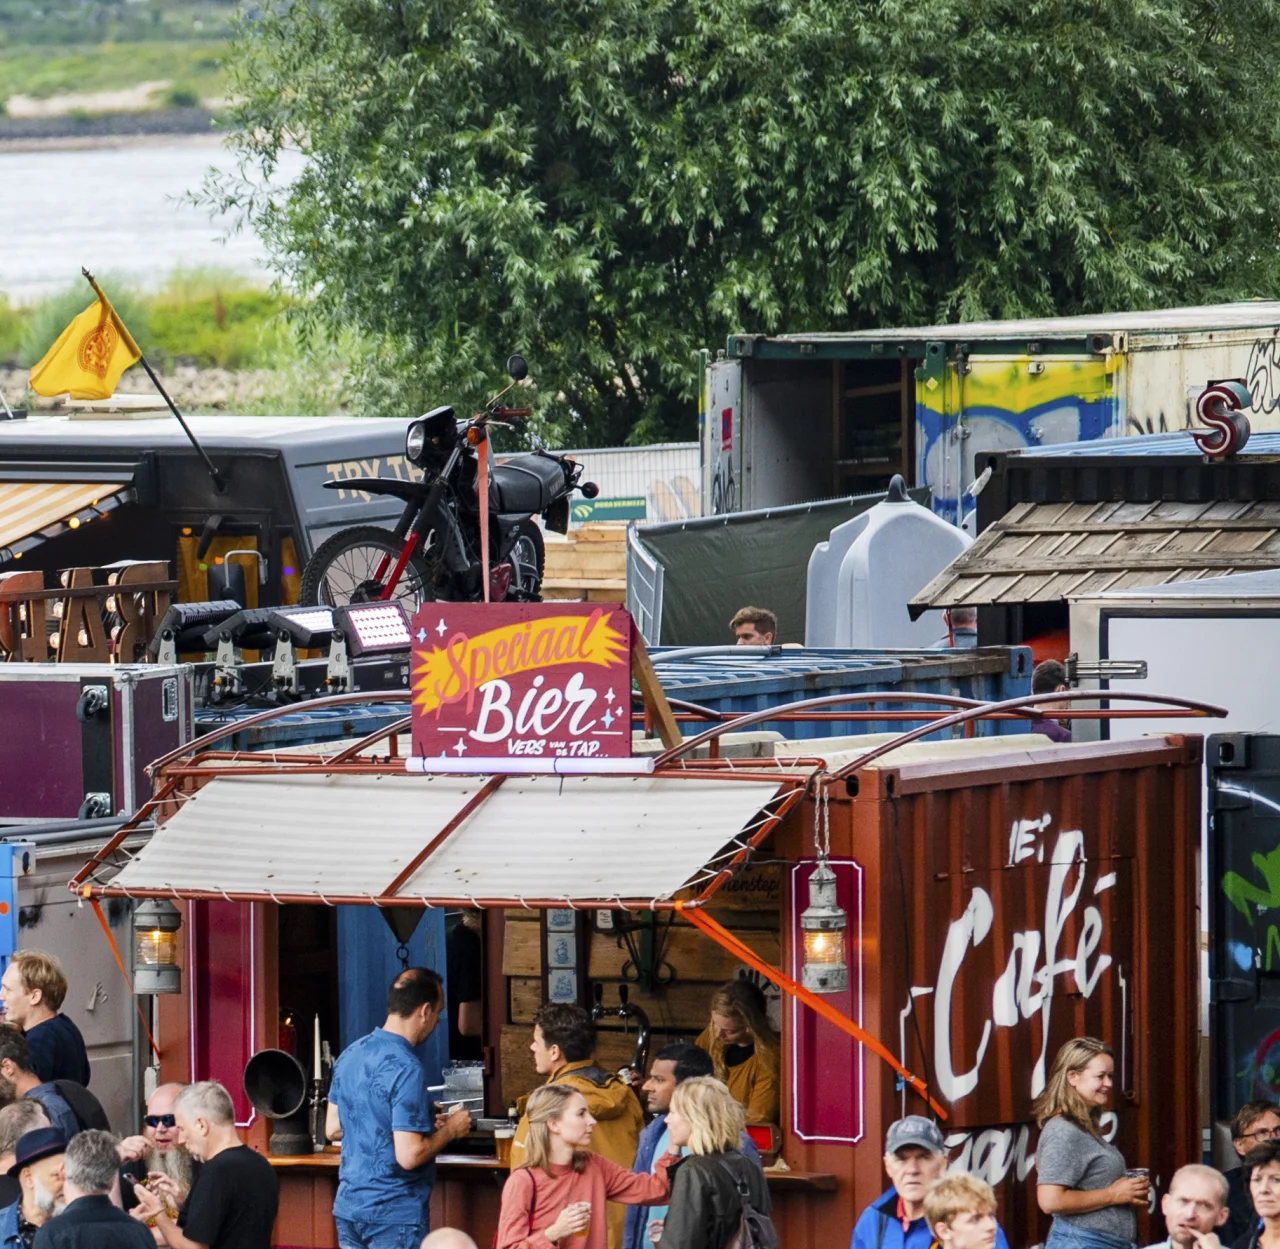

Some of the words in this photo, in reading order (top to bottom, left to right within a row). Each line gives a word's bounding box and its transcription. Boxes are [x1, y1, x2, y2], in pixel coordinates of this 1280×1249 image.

[1193, 385, 1241, 457] S
[434, 608, 604, 720] Speciaal
[468, 672, 598, 743] Bier
[507, 738, 546, 755] VERS
